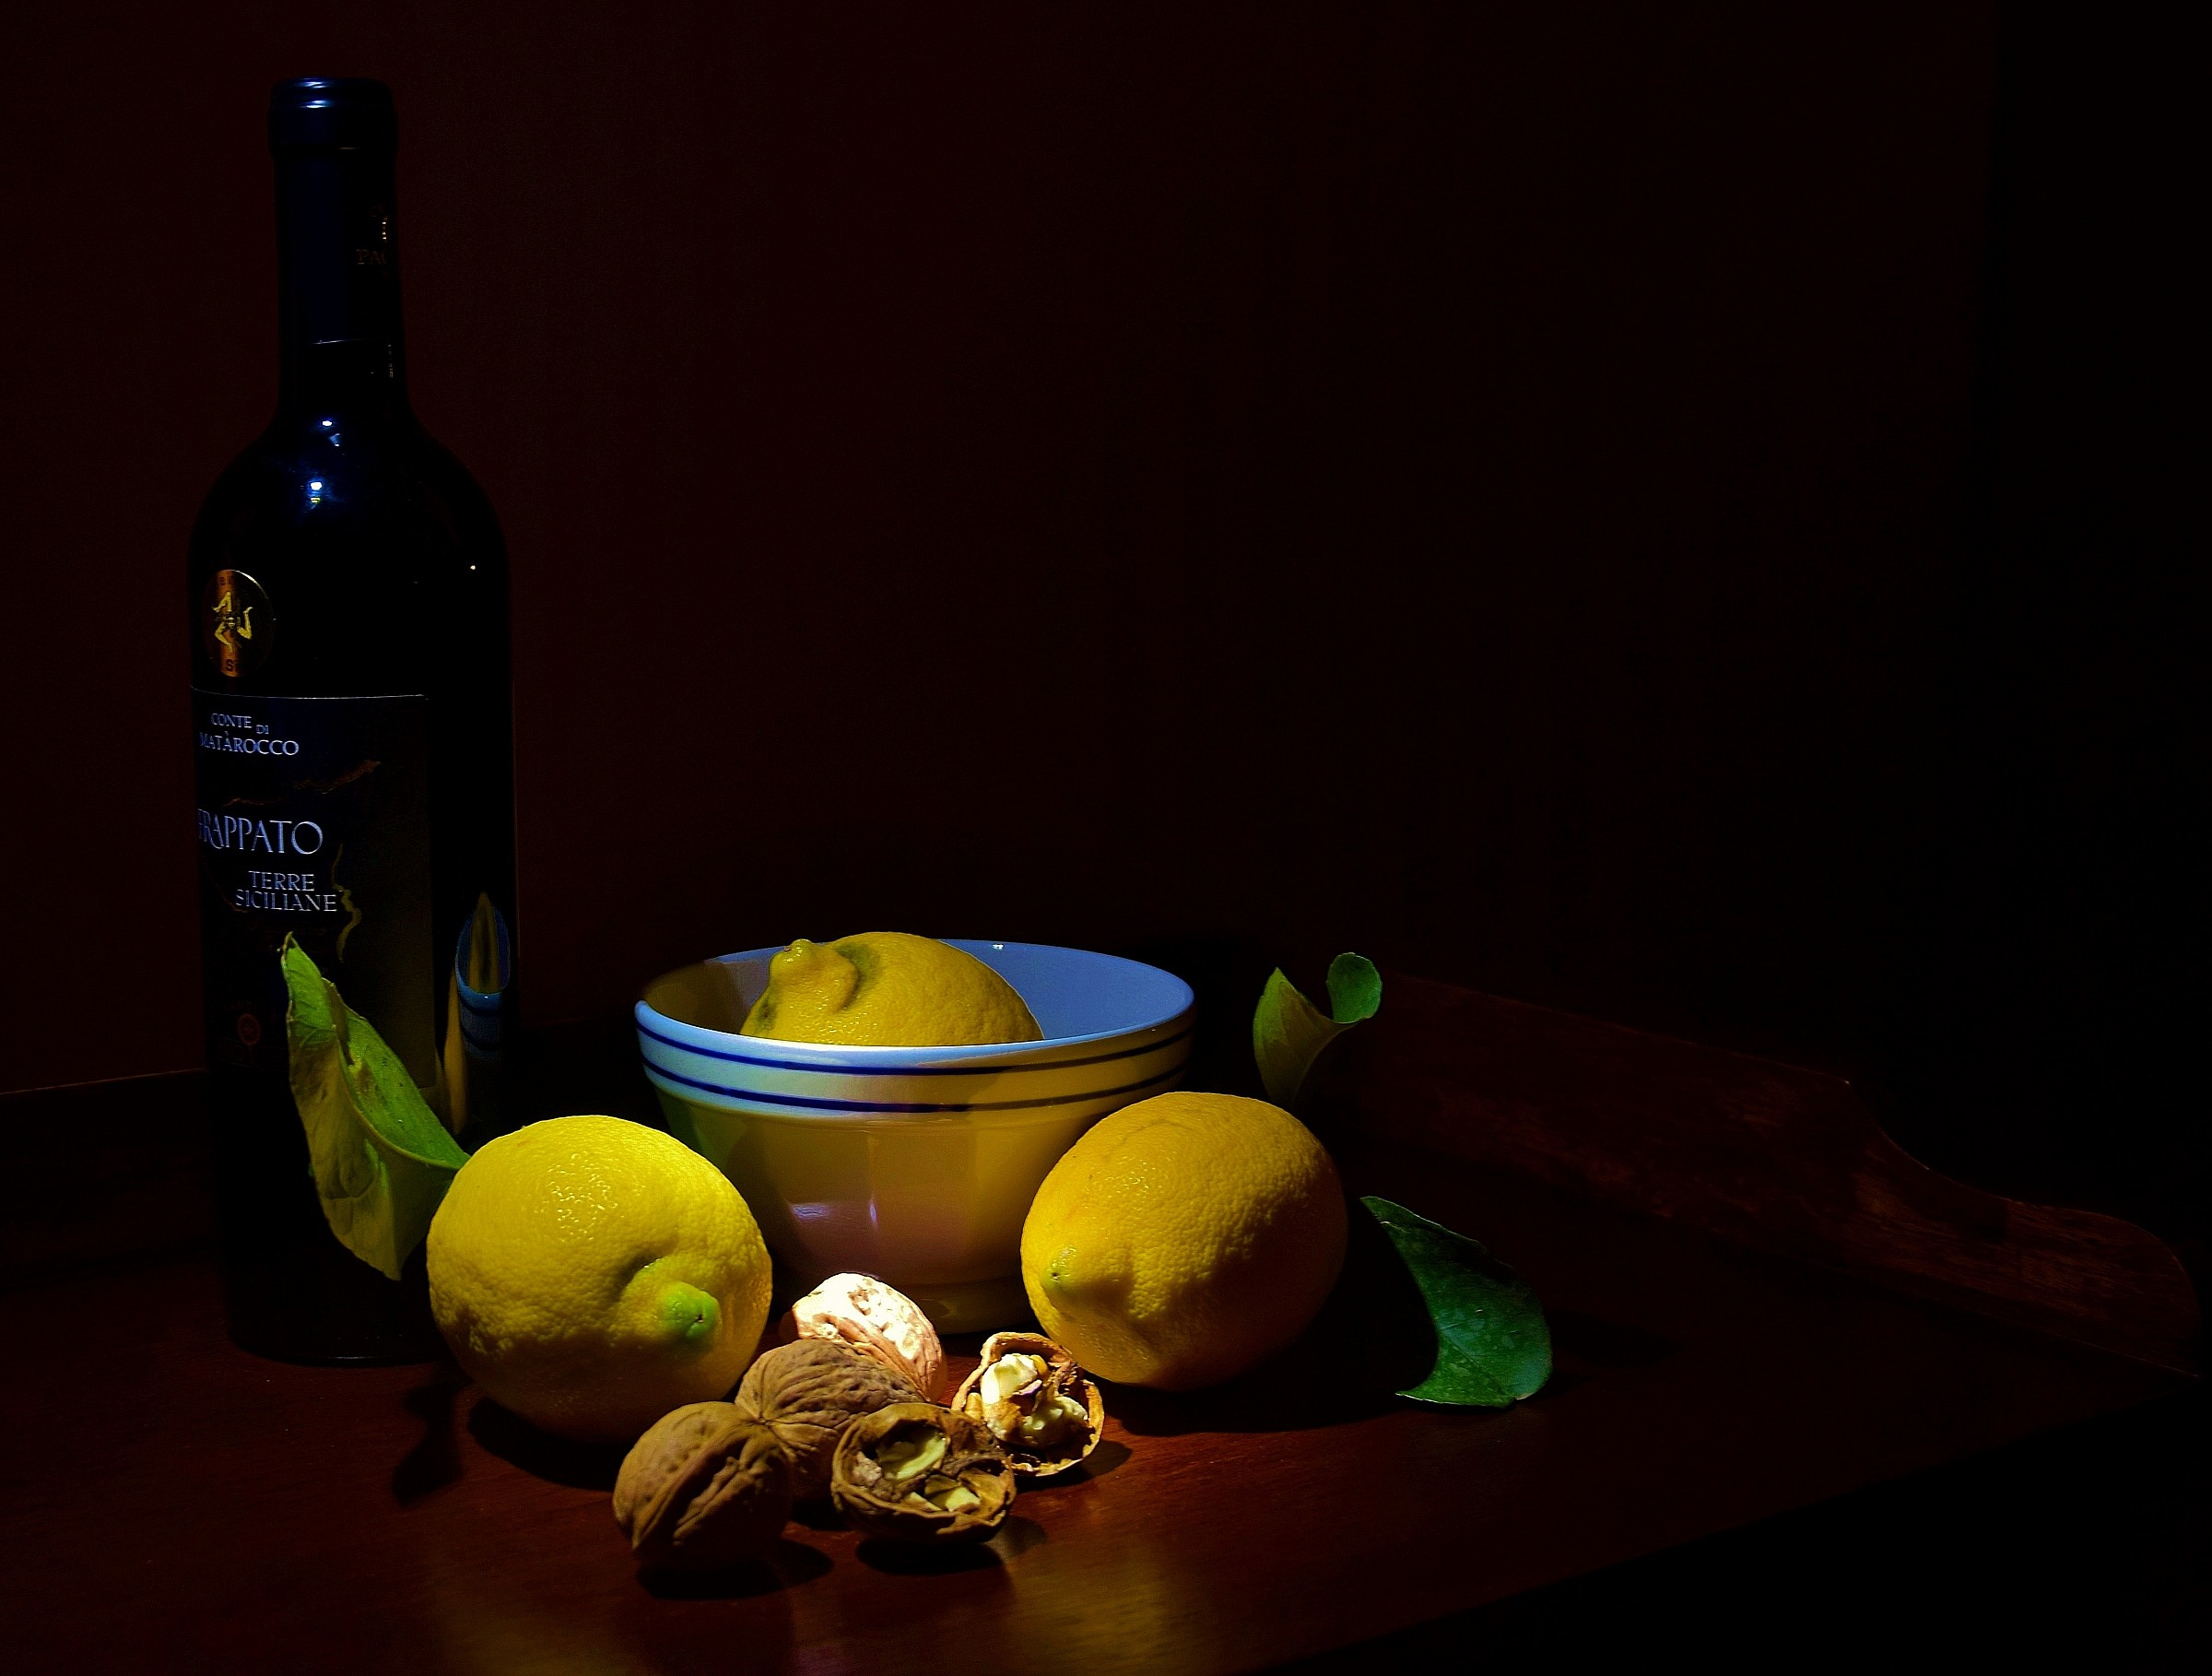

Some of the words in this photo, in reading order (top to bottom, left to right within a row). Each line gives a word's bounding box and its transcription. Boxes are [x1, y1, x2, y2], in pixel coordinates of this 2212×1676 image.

[210, 713, 253, 729] CONTE
[255, 724, 270, 736] DI
[196, 808, 324, 855] FRAPPATO
[248, 870, 315, 891] TERRE
[235, 889, 337, 912] SICILIANE
